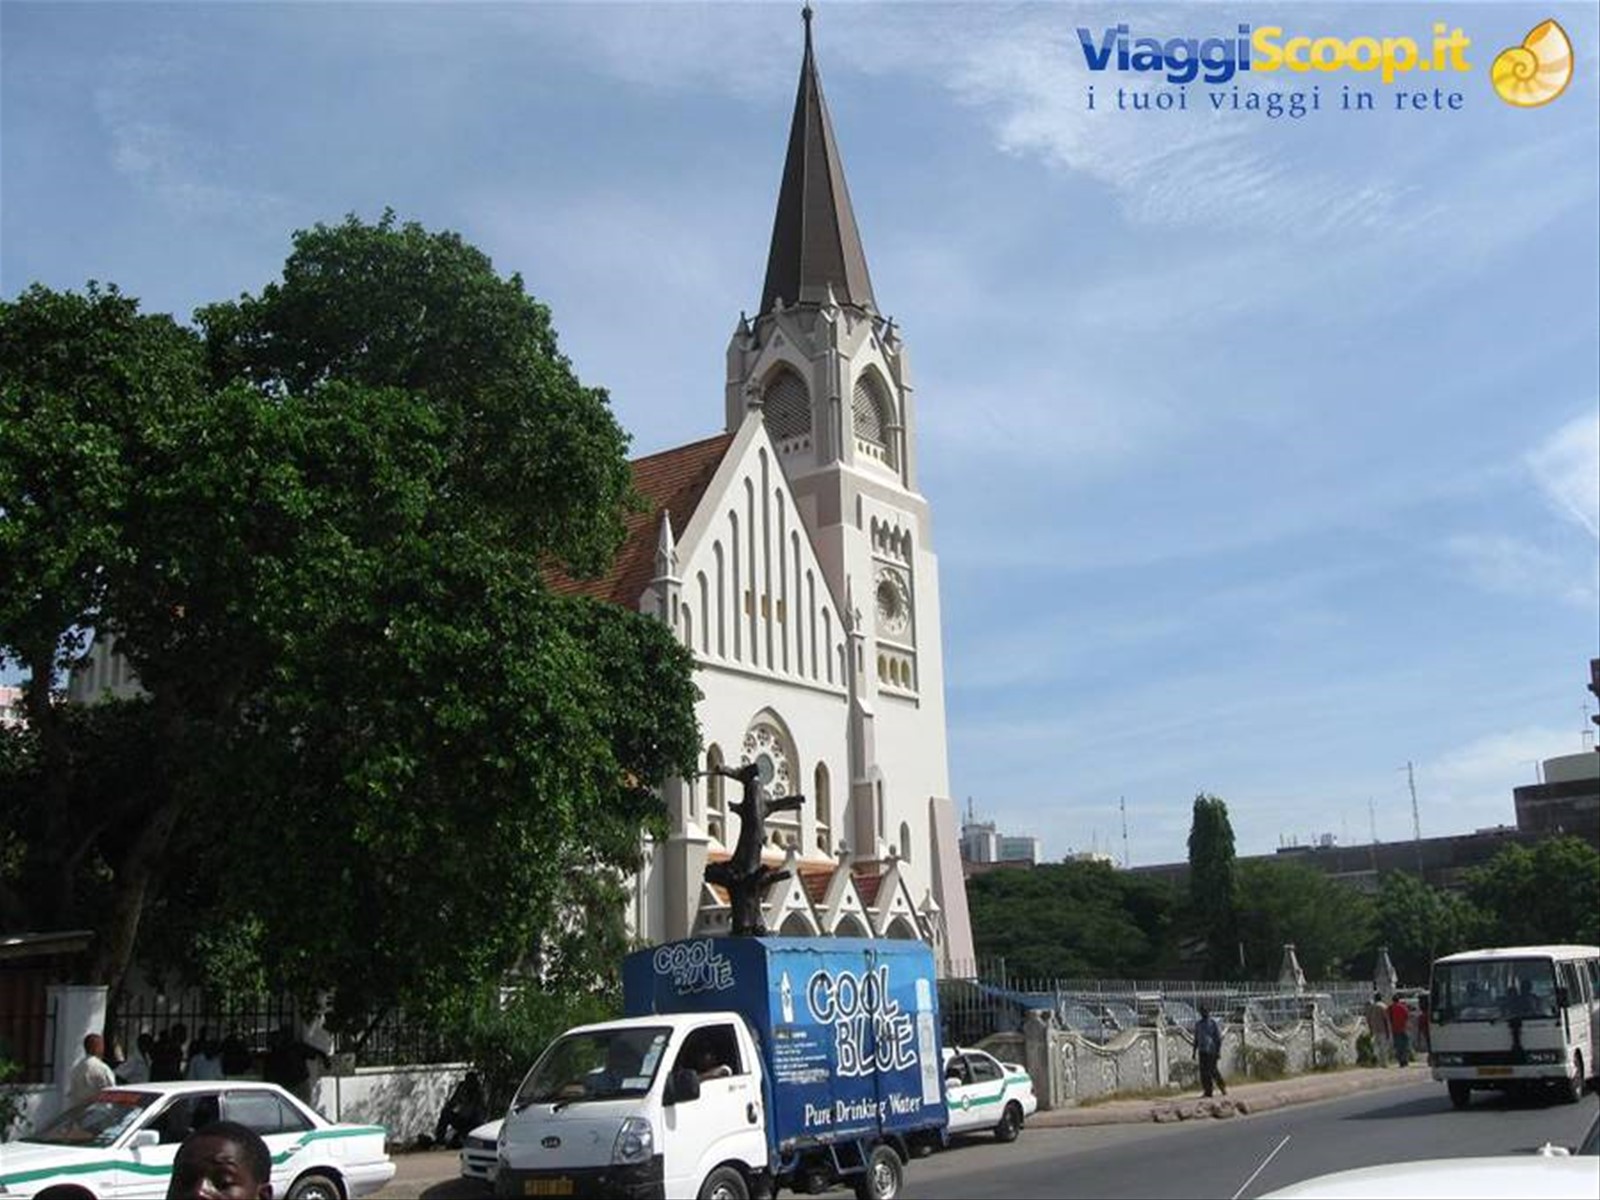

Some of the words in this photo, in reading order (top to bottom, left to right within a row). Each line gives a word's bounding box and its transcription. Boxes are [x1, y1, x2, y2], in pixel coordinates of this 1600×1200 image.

[653, 938, 722, 975] COOL
[806, 965, 899, 1025] COOL
[835, 1013, 917, 1077] BLUE
[805, 1103, 832, 1127] Pure
[836, 1097, 886, 1124] Drinking
[889, 1093, 922, 1115] Water
